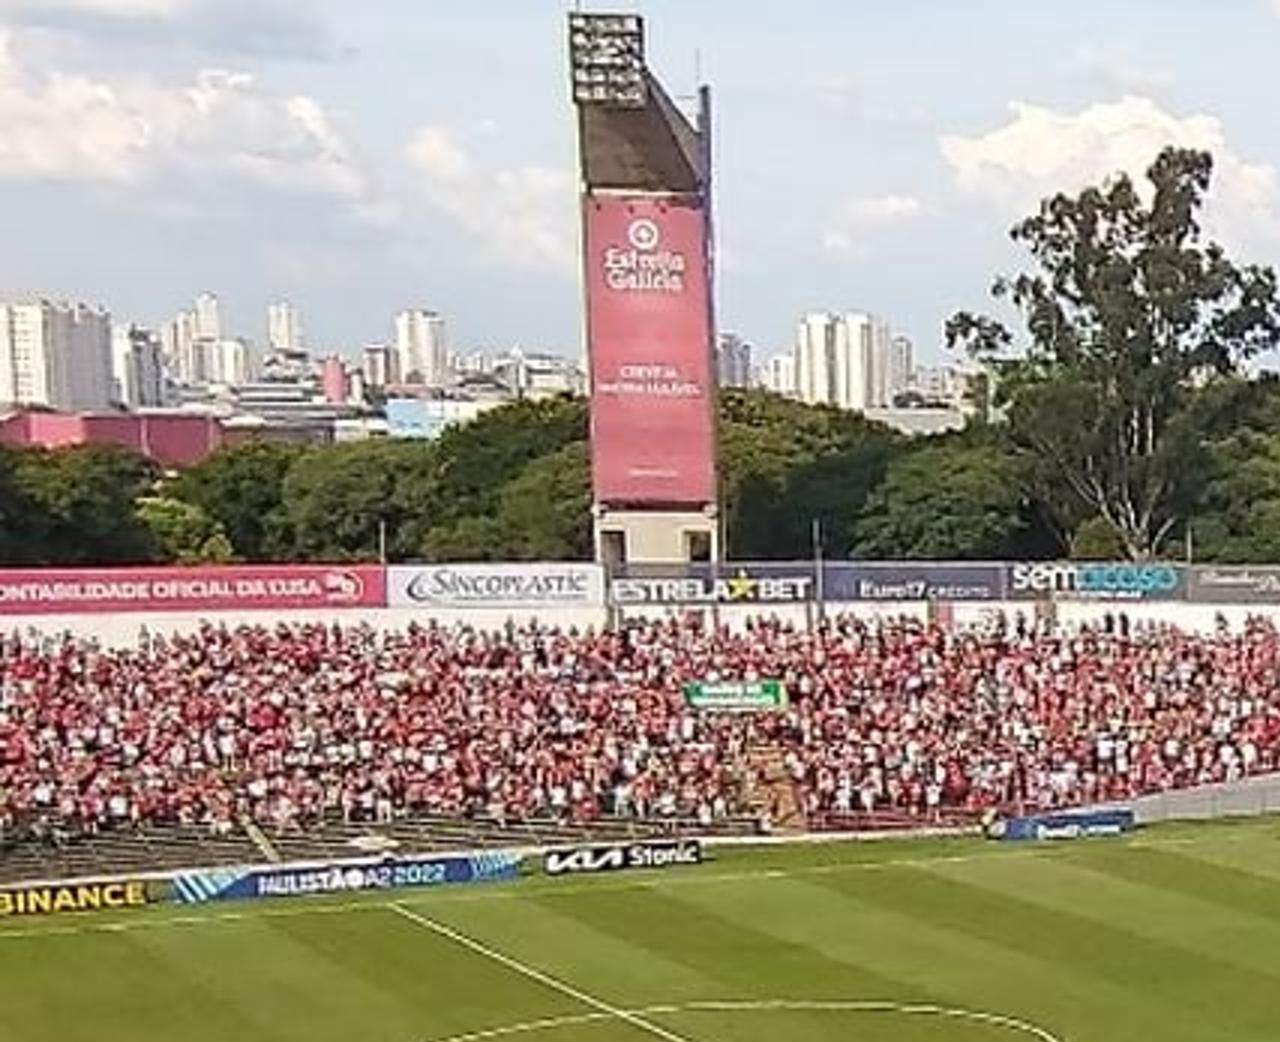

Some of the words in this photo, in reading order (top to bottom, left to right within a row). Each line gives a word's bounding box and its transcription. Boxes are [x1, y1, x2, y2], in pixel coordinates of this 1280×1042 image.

[603, 248, 685, 270] Estrella
[607, 270, 683, 291] Galicia
[613, 578, 730, 601] ESTRELA
[758, 577, 812, 600] BET
[628, 841, 699, 865] Stonic
